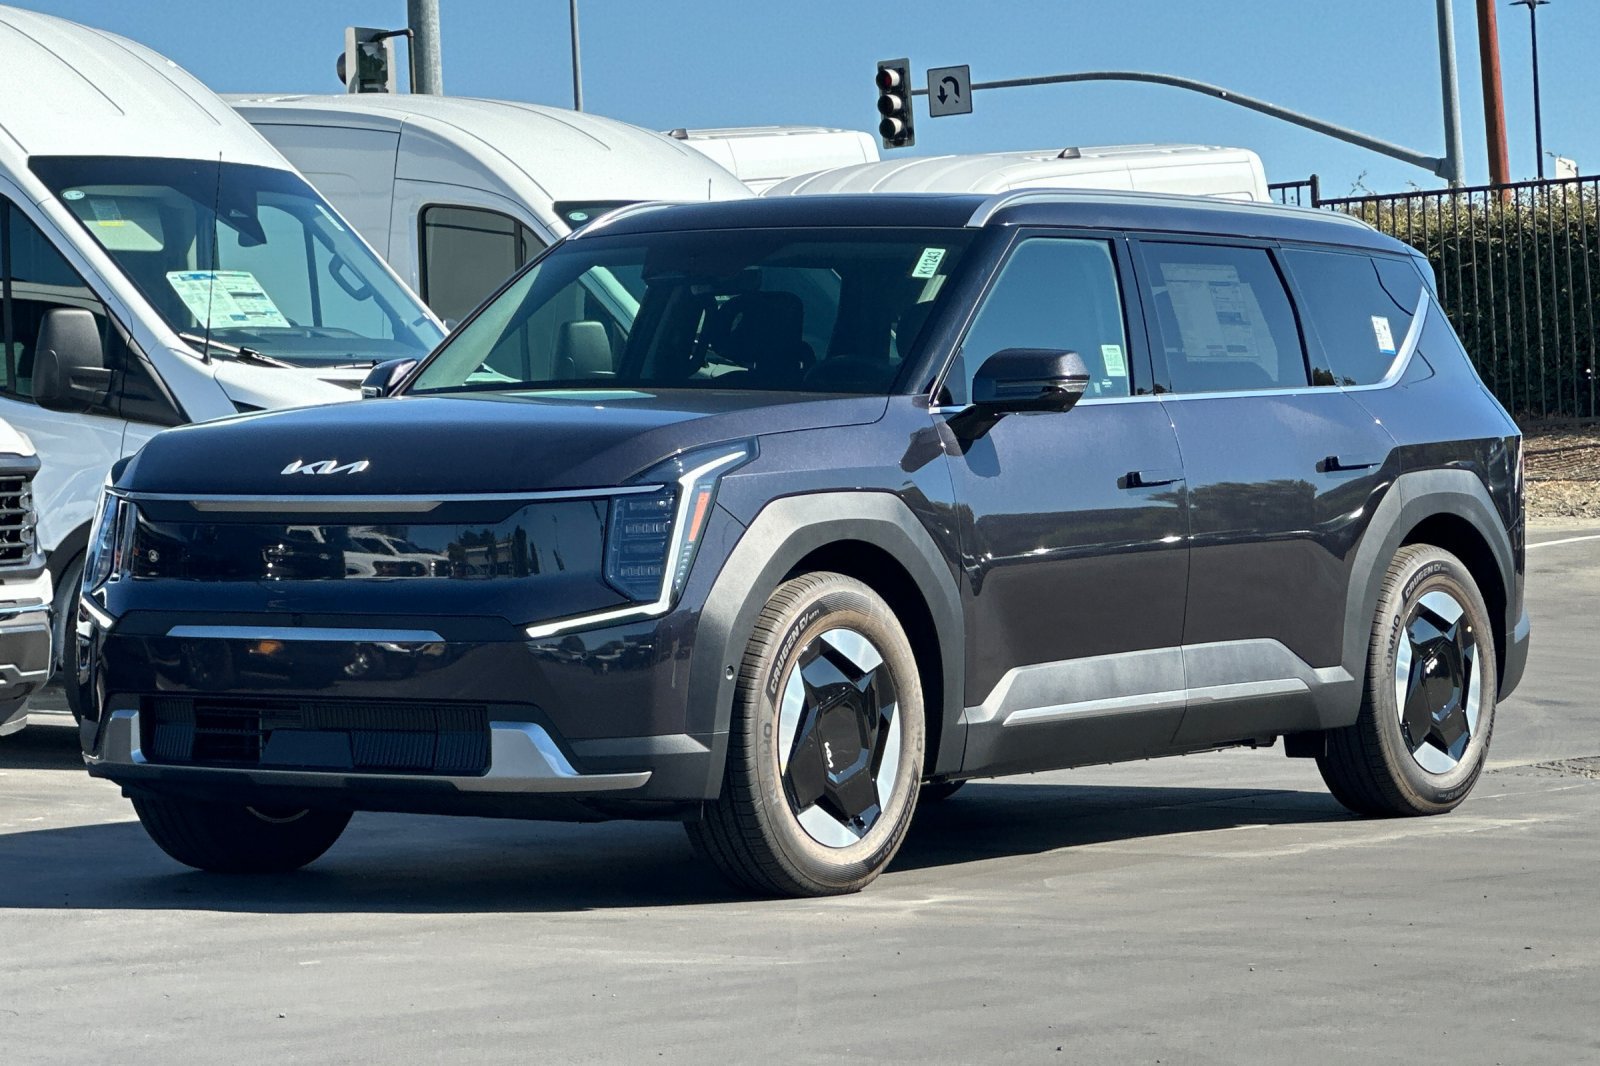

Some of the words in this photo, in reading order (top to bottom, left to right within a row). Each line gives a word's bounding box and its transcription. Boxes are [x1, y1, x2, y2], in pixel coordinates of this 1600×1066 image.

[917, 251, 942, 275] K11243
[280, 460, 370, 475] KIA
[1405, 563, 1434, 599] CRUGEN
[770, 625, 801, 695] CRUGEN
